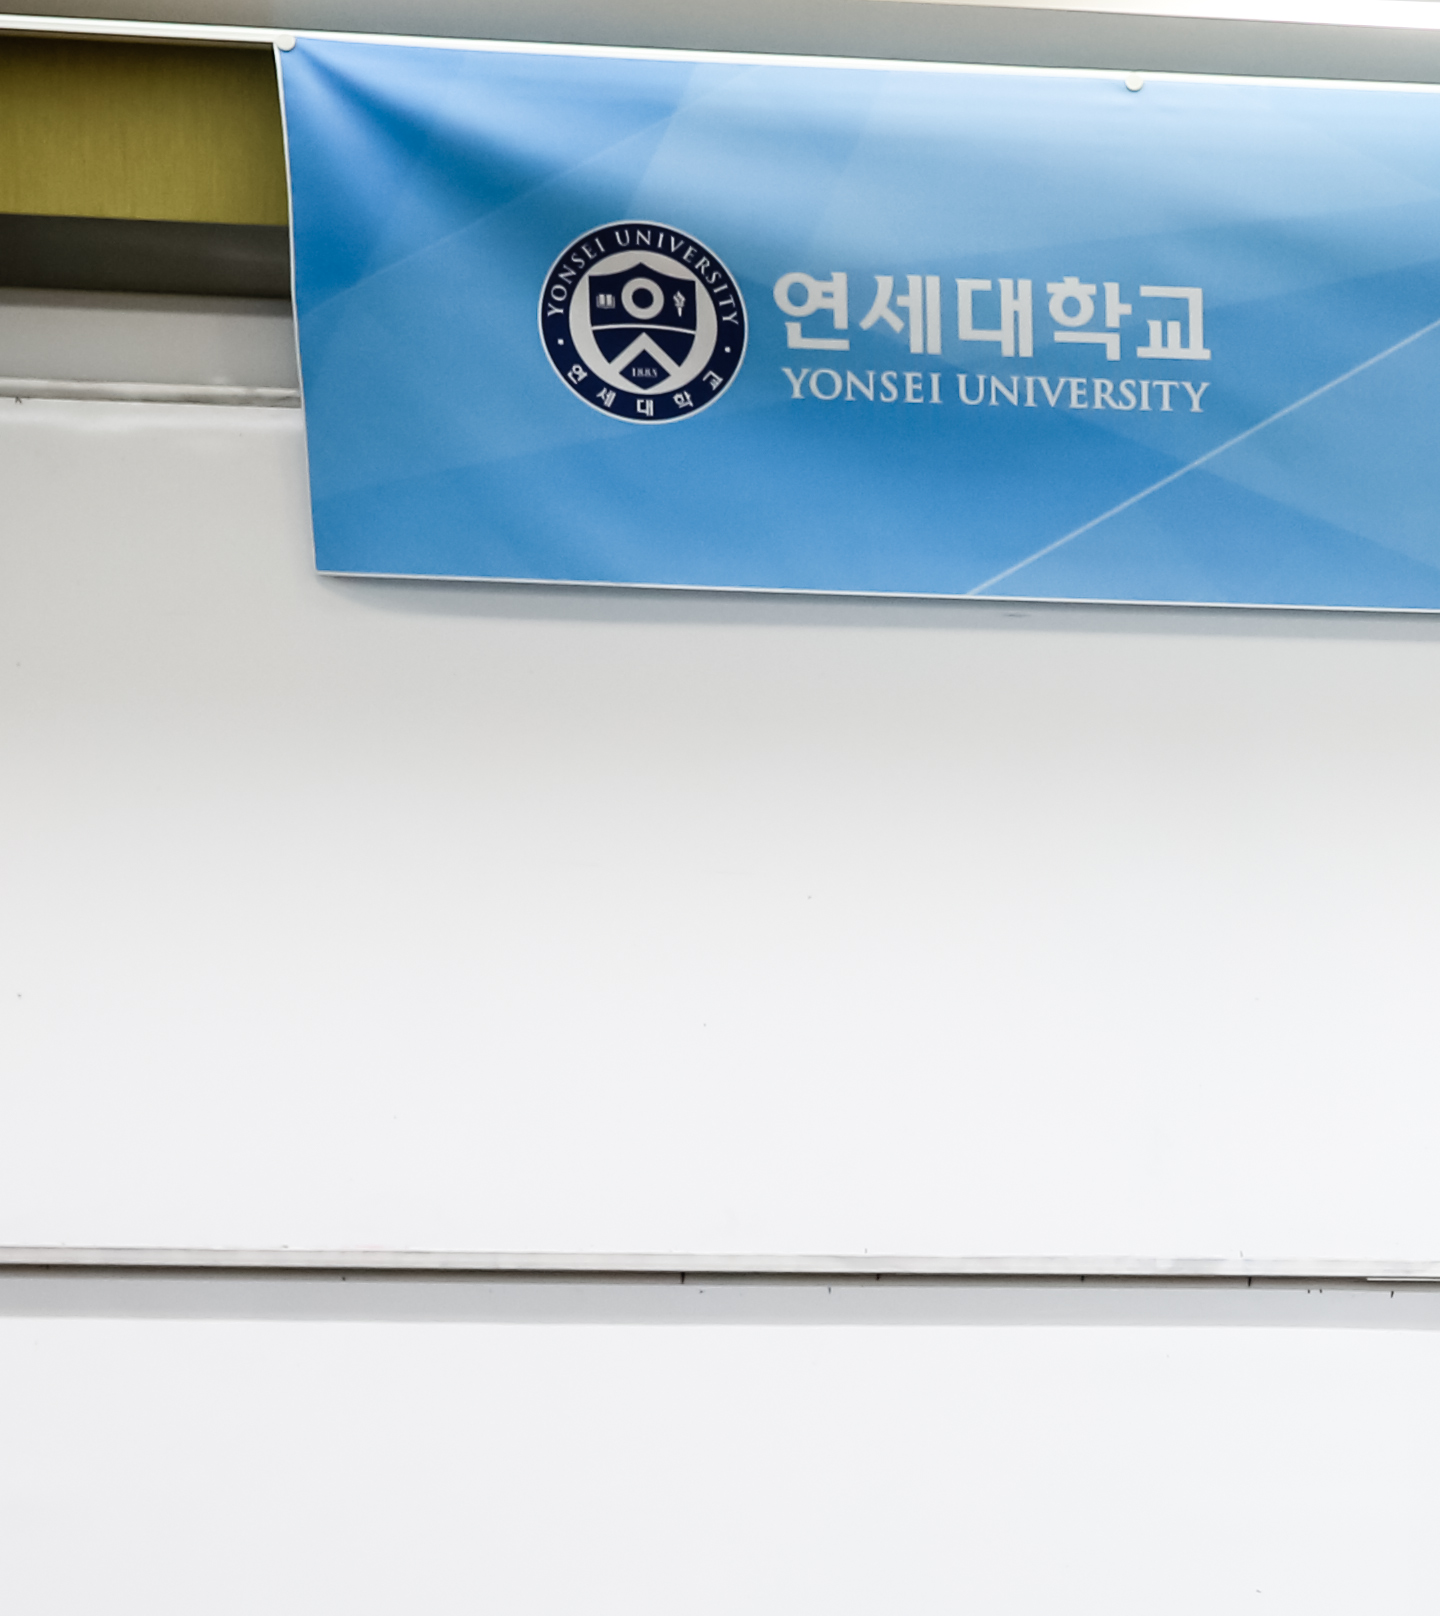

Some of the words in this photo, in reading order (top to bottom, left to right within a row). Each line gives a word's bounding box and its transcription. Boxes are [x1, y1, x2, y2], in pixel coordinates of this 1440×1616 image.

[548, 238, 605, 317] YONSEI
[614, 229, 739, 325] UNIVERSITY
[773, 270, 1212, 362] 연세대학교
[781, 367, 943, 405] YONSEI
[956, 373, 1211, 413] UNIVERSITY
